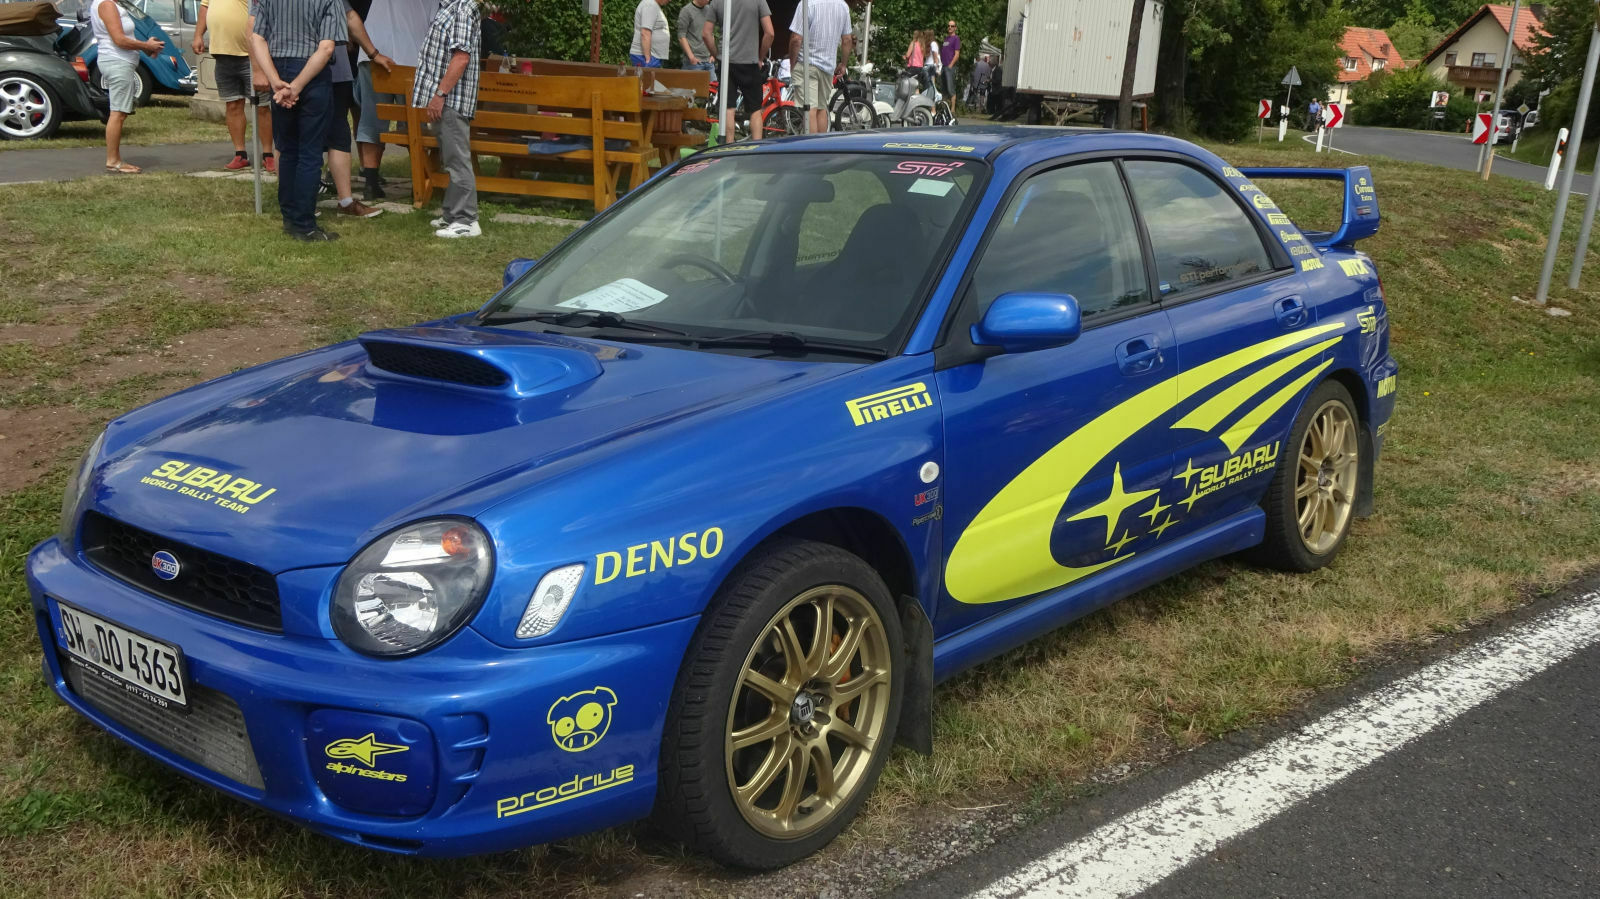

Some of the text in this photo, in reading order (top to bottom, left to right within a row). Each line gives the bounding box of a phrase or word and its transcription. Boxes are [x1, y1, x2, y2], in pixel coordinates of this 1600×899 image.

[882, 142, 975, 153] prodrive
[845, 381, 934, 427] PIRELLI
[151, 460, 277, 504] SUBARU
[1197, 461, 1276, 497] WORLD RALLY TEAM
[1199, 440, 1280, 489] SUBARU
[140, 476, 251, 514] WORLD RALLY TEAM
[594, 527, 724, 585] DENSO
[61, 608, 87, 654] SW
[95, 623, 124, 673] DO
[127, 637, 182, 697] 4363
[326, 761, 407, 783] alpinestars
[496, 764, 635, 818] prodrive
